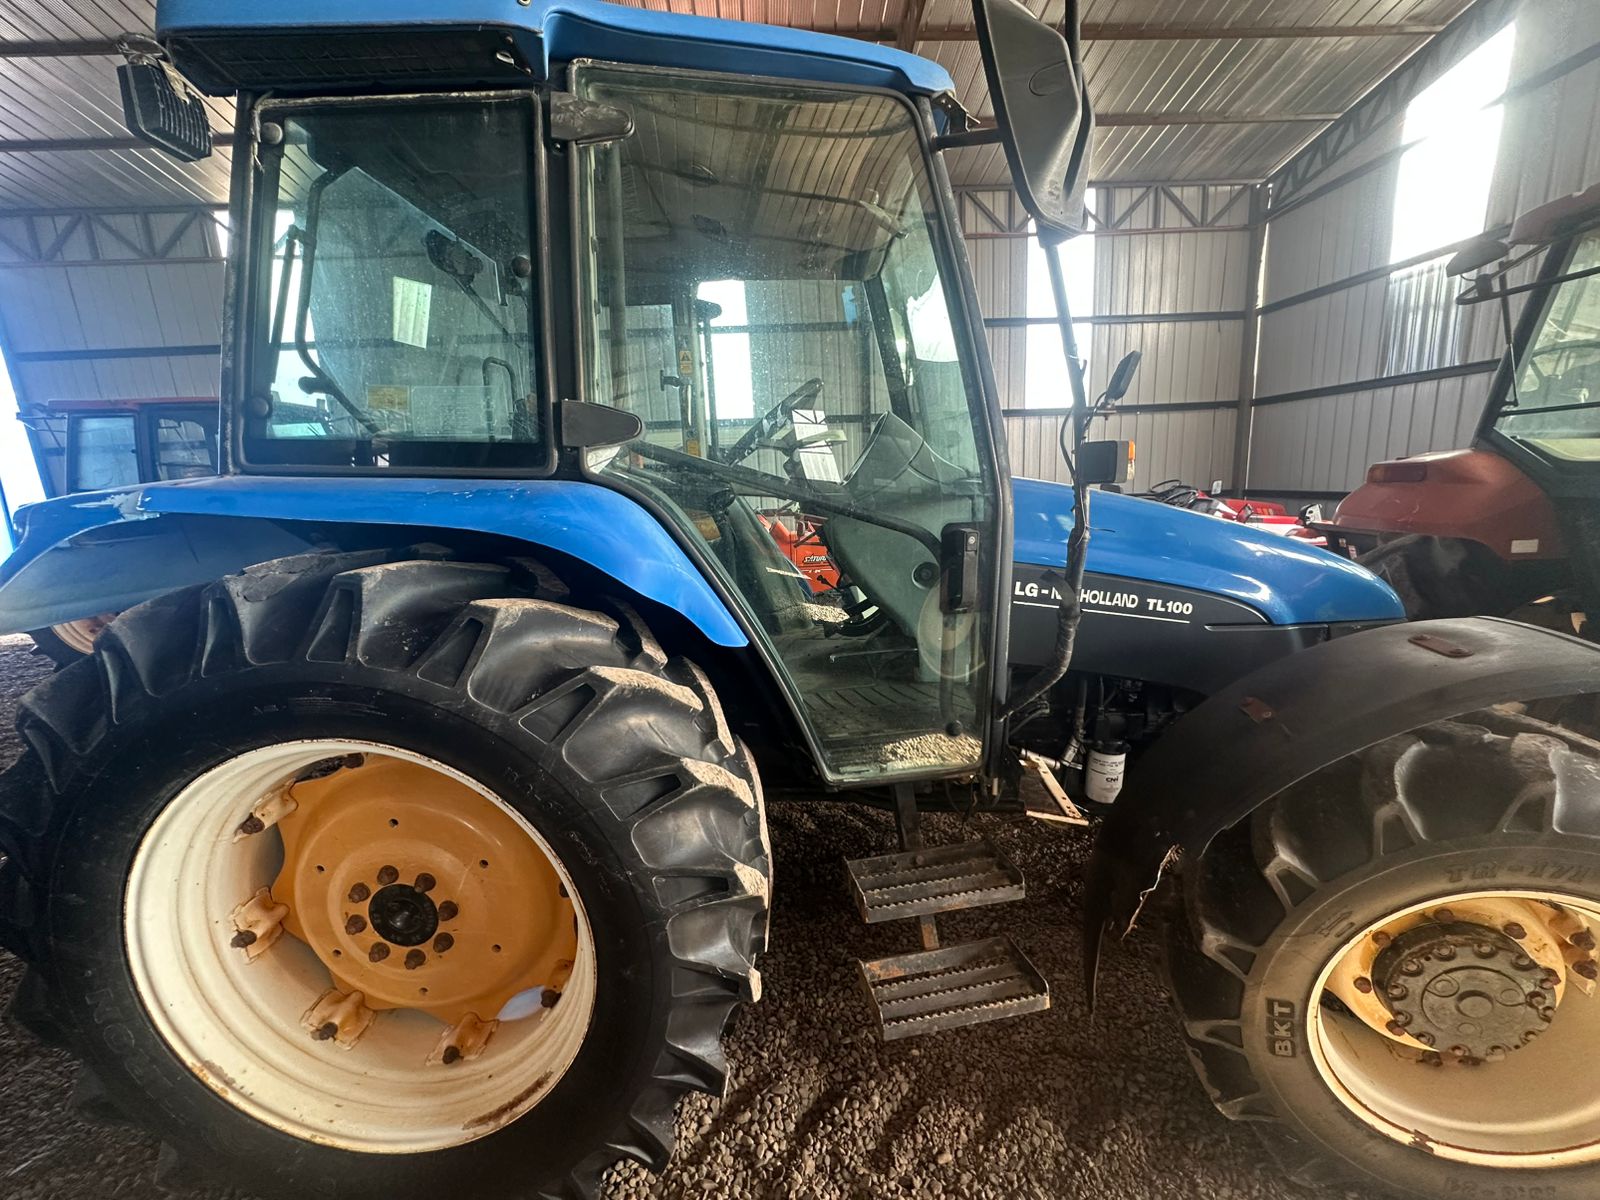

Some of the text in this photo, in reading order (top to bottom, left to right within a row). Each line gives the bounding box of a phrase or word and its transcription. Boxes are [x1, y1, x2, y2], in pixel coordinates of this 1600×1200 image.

[1080, 589, 1139, 609] HOLLAND
[1147, 598, 1193, 615] TL100
[1273, 1001, 1293, 1057] BKT
